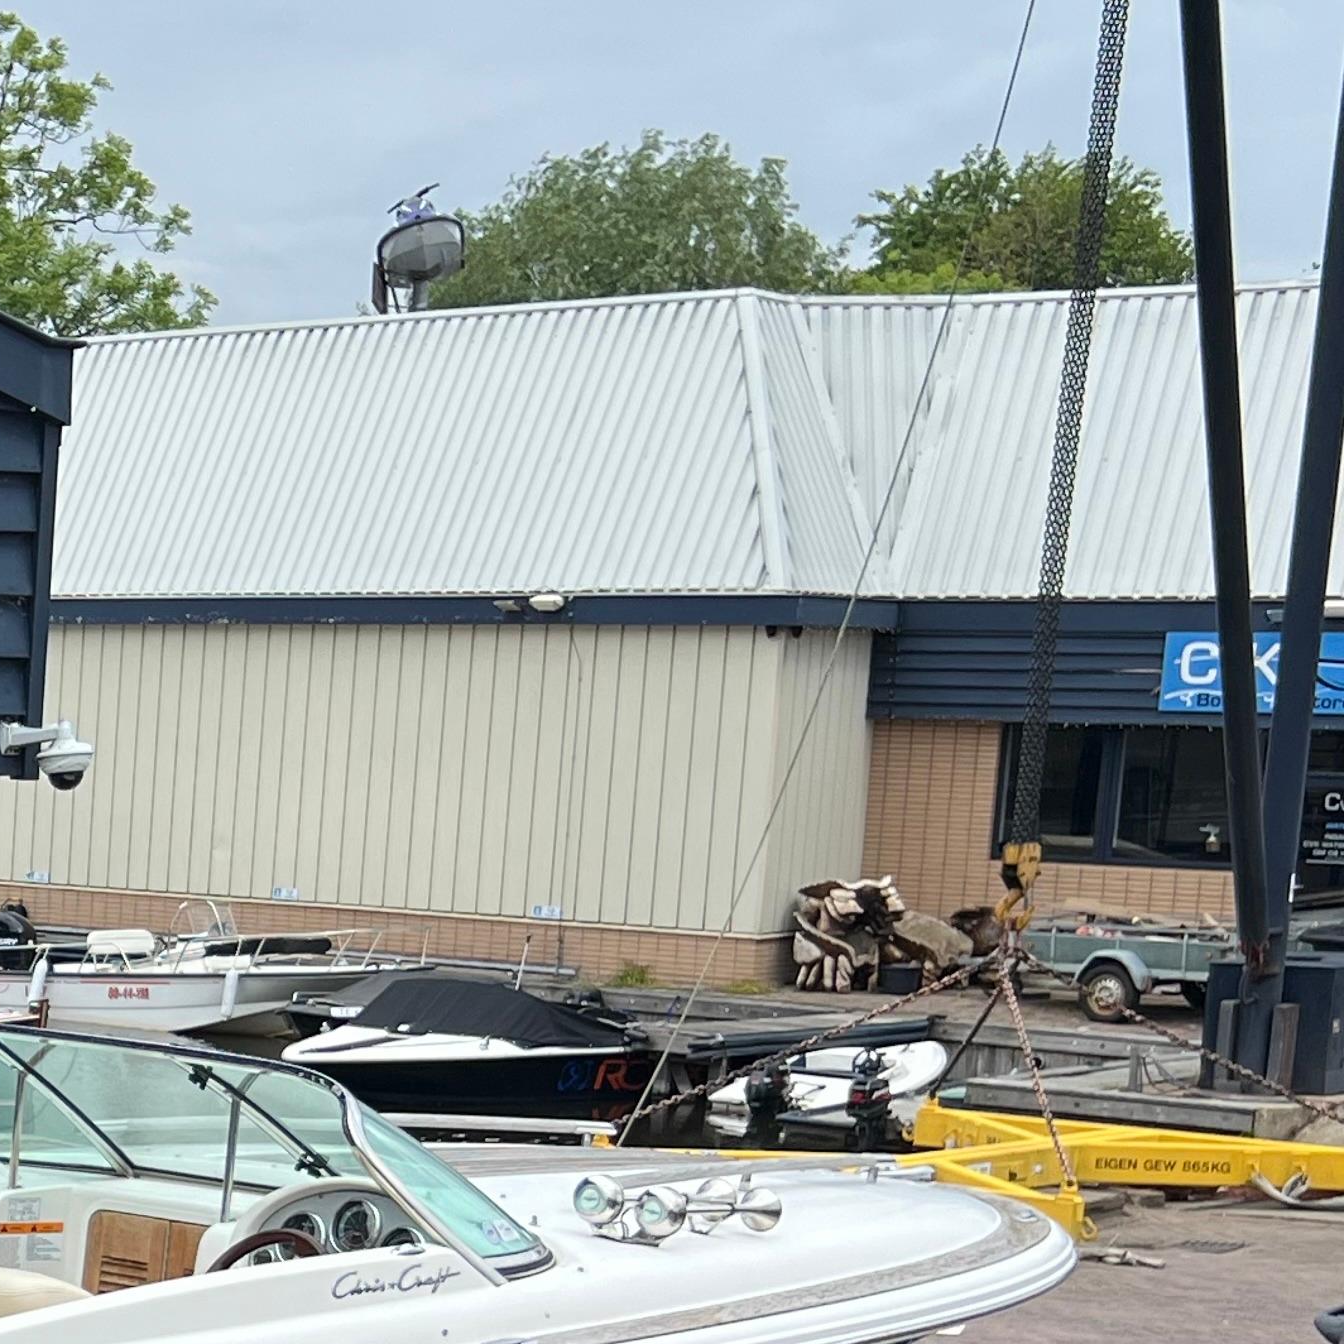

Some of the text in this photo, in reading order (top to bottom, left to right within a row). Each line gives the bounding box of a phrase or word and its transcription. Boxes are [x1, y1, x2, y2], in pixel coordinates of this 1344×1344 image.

[1180, 641, 1281, 685] CK
[1094, 1157, 1232, 1174] EIGEN GEW 865KG
